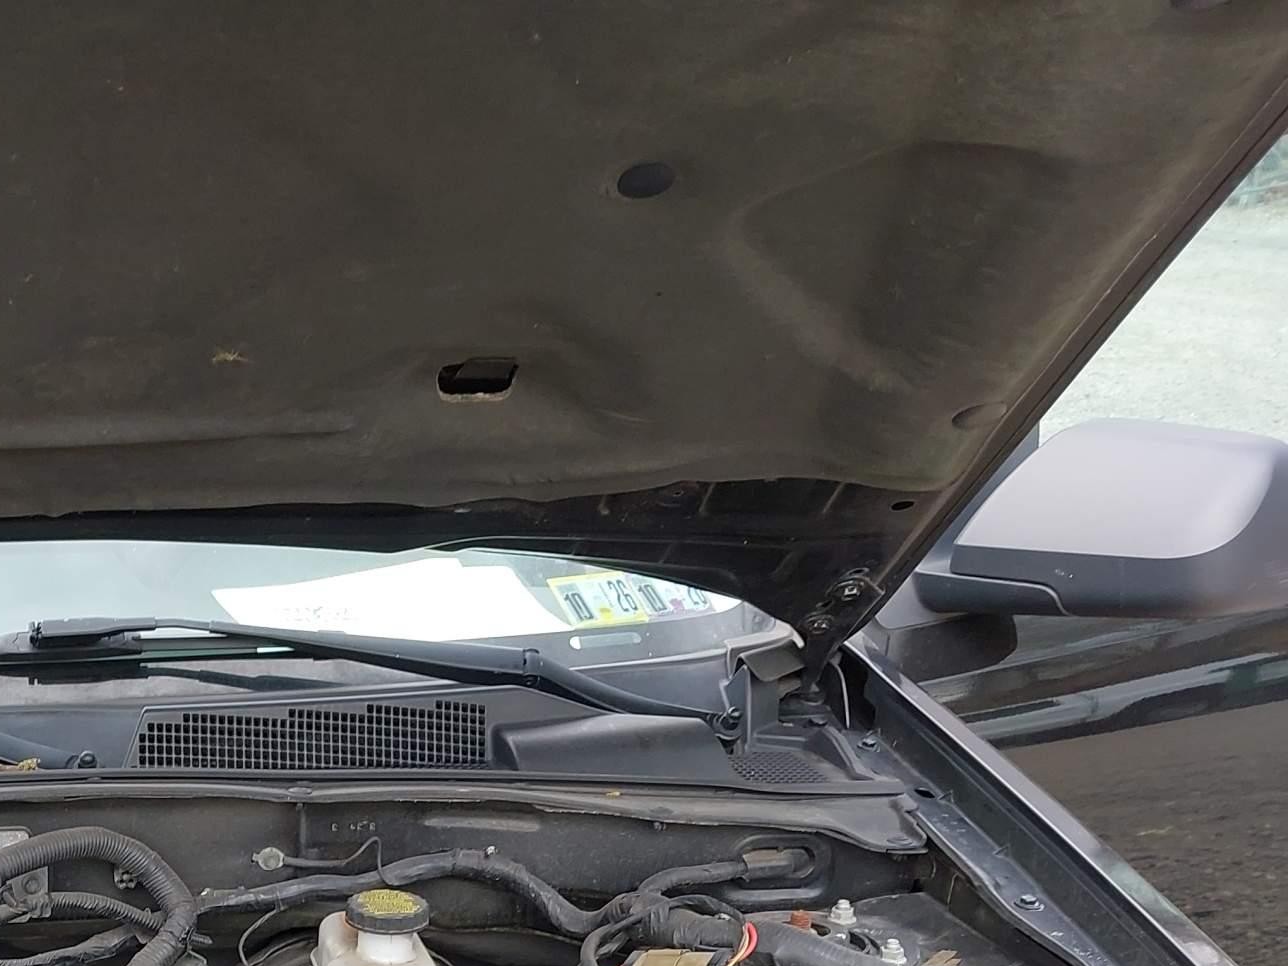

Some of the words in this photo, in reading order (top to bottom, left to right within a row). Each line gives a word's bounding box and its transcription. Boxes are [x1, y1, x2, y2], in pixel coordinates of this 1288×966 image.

[564, 593, 594, 621] 10
[607, 580, 637, 612] 26
[638, 584, 667, 611] 10
